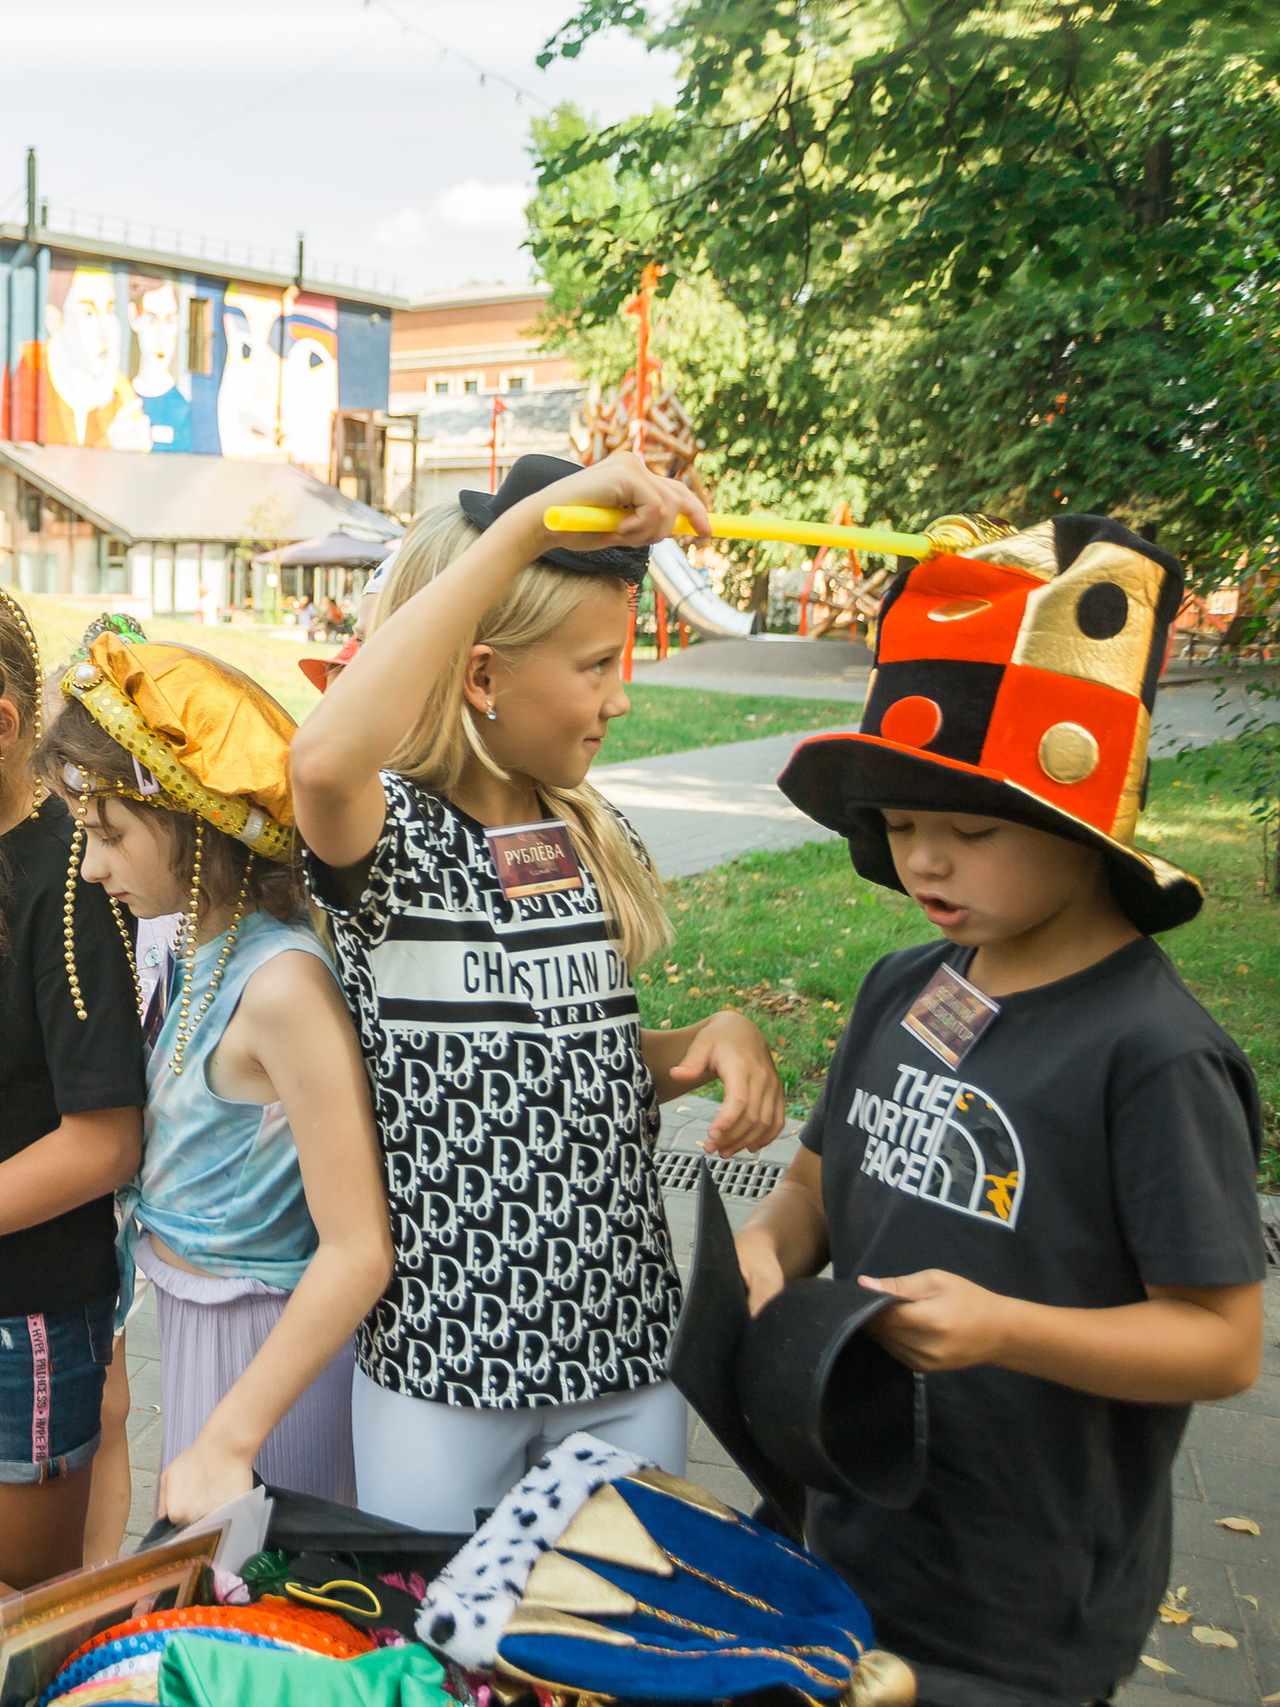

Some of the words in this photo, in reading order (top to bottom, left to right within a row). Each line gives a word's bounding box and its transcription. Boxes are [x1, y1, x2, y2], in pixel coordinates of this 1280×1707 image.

[504, 841, 566, 867] РУБЛЁВА
[893, 1063, 960, 1117] THE
[846, 1088, 942, 1157] NORTH
[860, 1135, 928, 1197] FACE
[32, 1327, 46, 1357] HYPE
[35, 1358, 48, 1410] PRINCESS
[35, 1417, 47, 1444] HYPE
